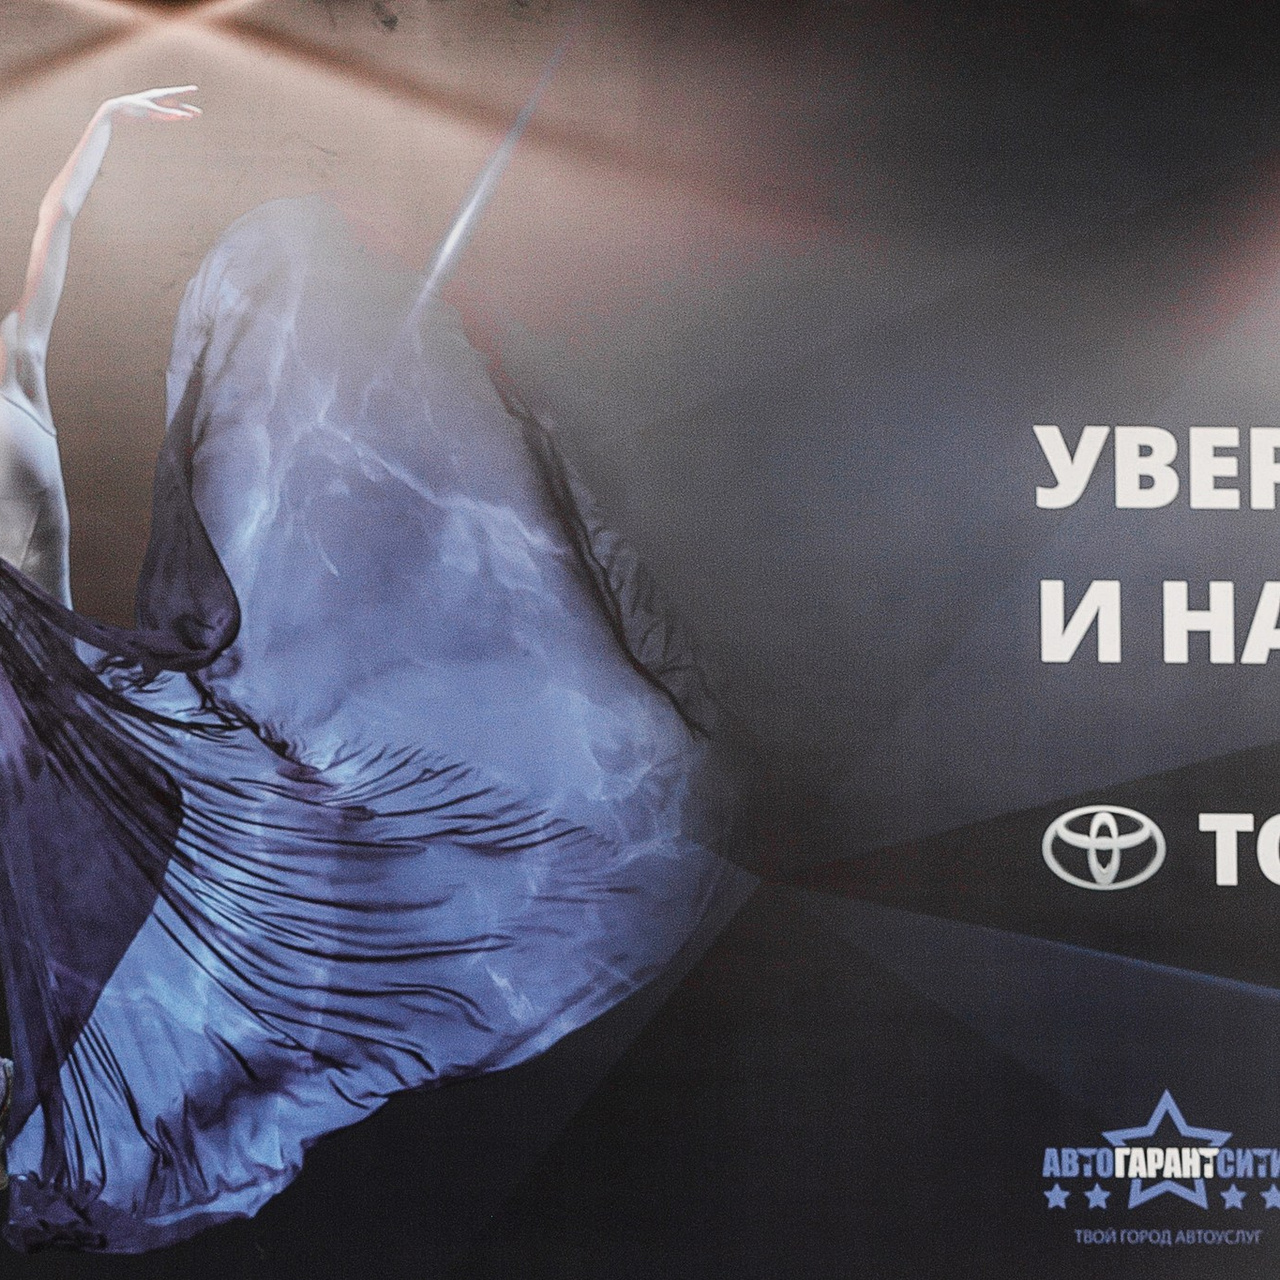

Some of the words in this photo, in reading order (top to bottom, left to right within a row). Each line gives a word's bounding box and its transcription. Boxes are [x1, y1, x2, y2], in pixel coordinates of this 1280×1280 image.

[1040, 579, 1121, 664] И
[1074, 1227, 1117, 1245] ТВОЙ
[1120, 1229, 1172, 1247] ГОРОД
[1175, 1229, 1264, 1245] АВТОУСЛУГ
